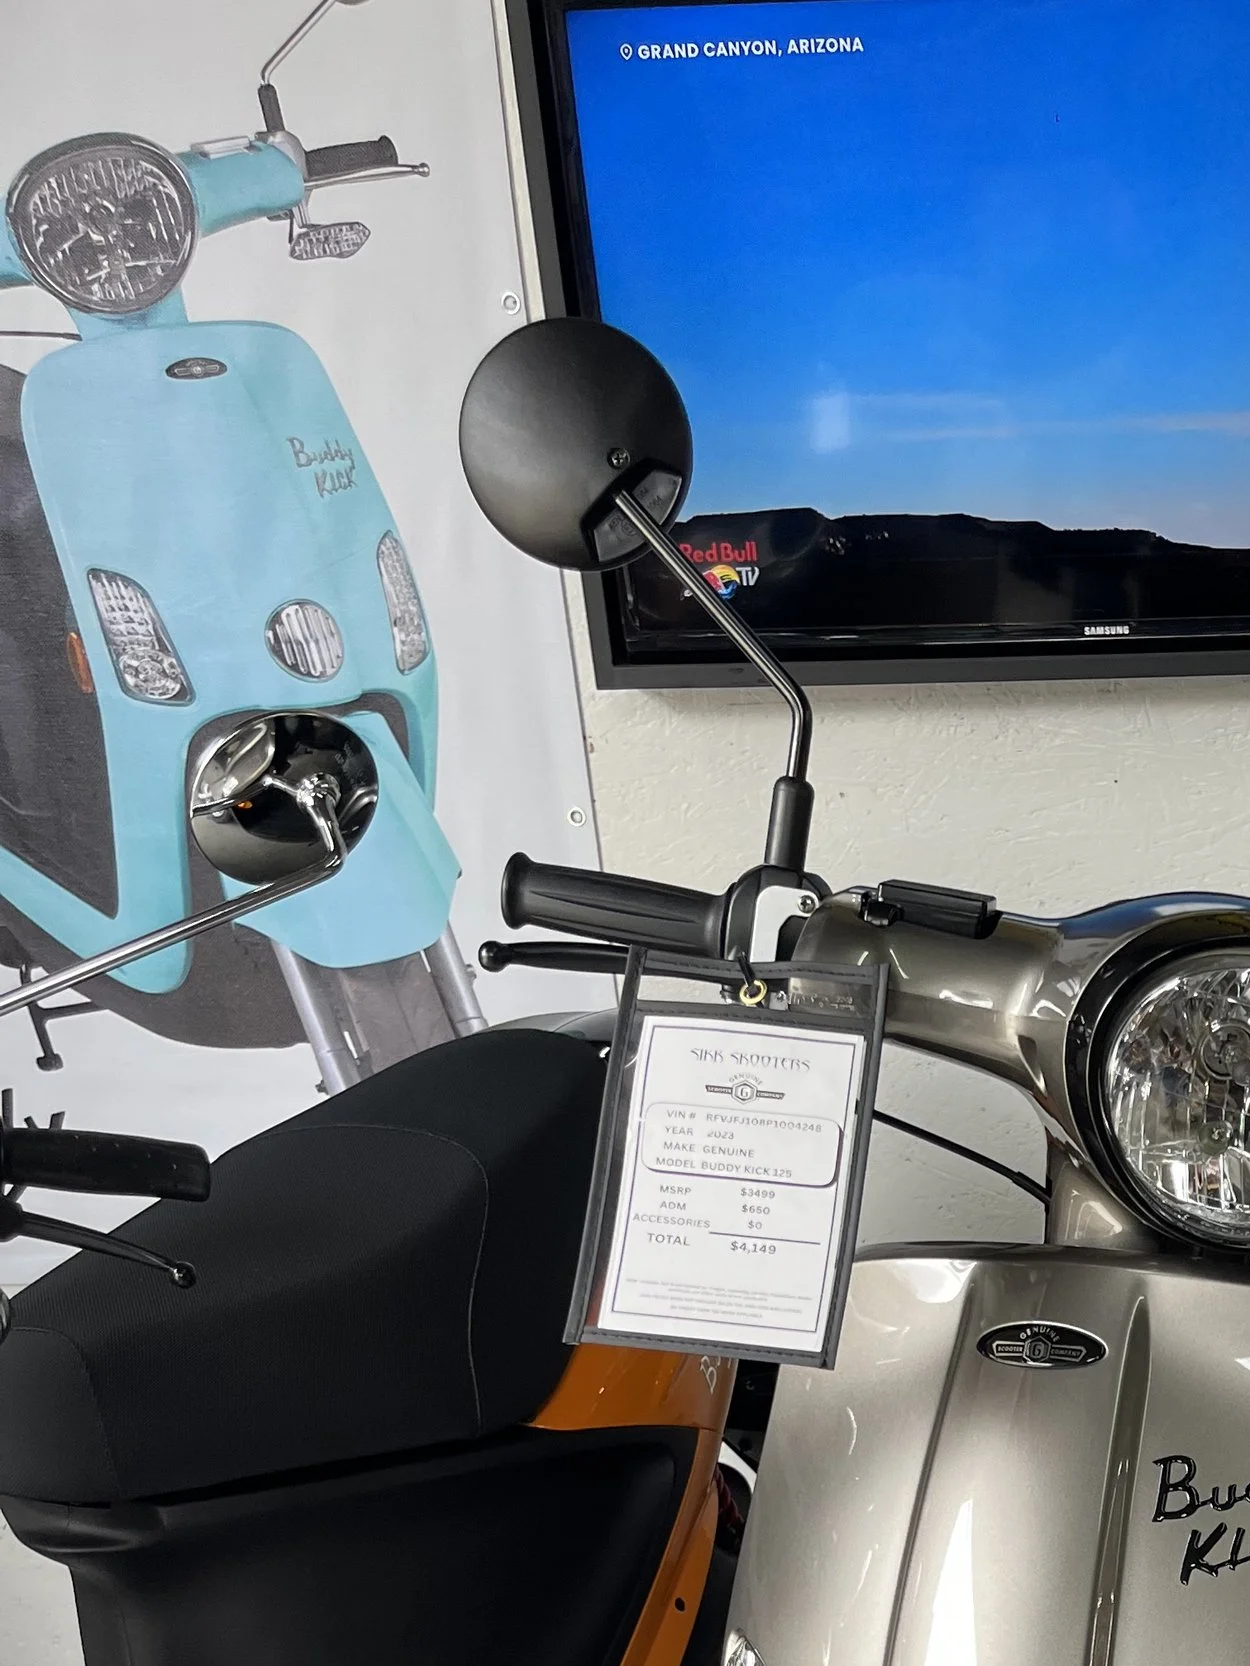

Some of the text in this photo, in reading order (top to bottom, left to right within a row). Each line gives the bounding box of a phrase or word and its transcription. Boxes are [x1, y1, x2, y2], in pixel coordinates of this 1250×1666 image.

[637, 36, 864, 60] GRAND CANYON, ARIZONA
[286, 436, 355, 469] Buddy
[679, 540, 758, 563] Red Bull
[735, 566, 760, 586] TV
[1084, 625, 1130, 635] SAMSUNG
[667, 1110, 686, 1120] VIN
[665, 1126, 694, 1137] YEAR
[663, 1141, 755, 1158] MAKE GENUINE
[656, 1157, 792, 1179] MODEL BUDDY KICK 125
[659, 1185, 776, 1199] MSRP $3499
[659, 1200, 771, 1215] ADM $650
[632, 1214, 763, 1230] ACCESSORIES $0
[647, 1232, 777, 1255] TOTAL $4,149
[1020, 1326, 1060, 1342] GENUINE
